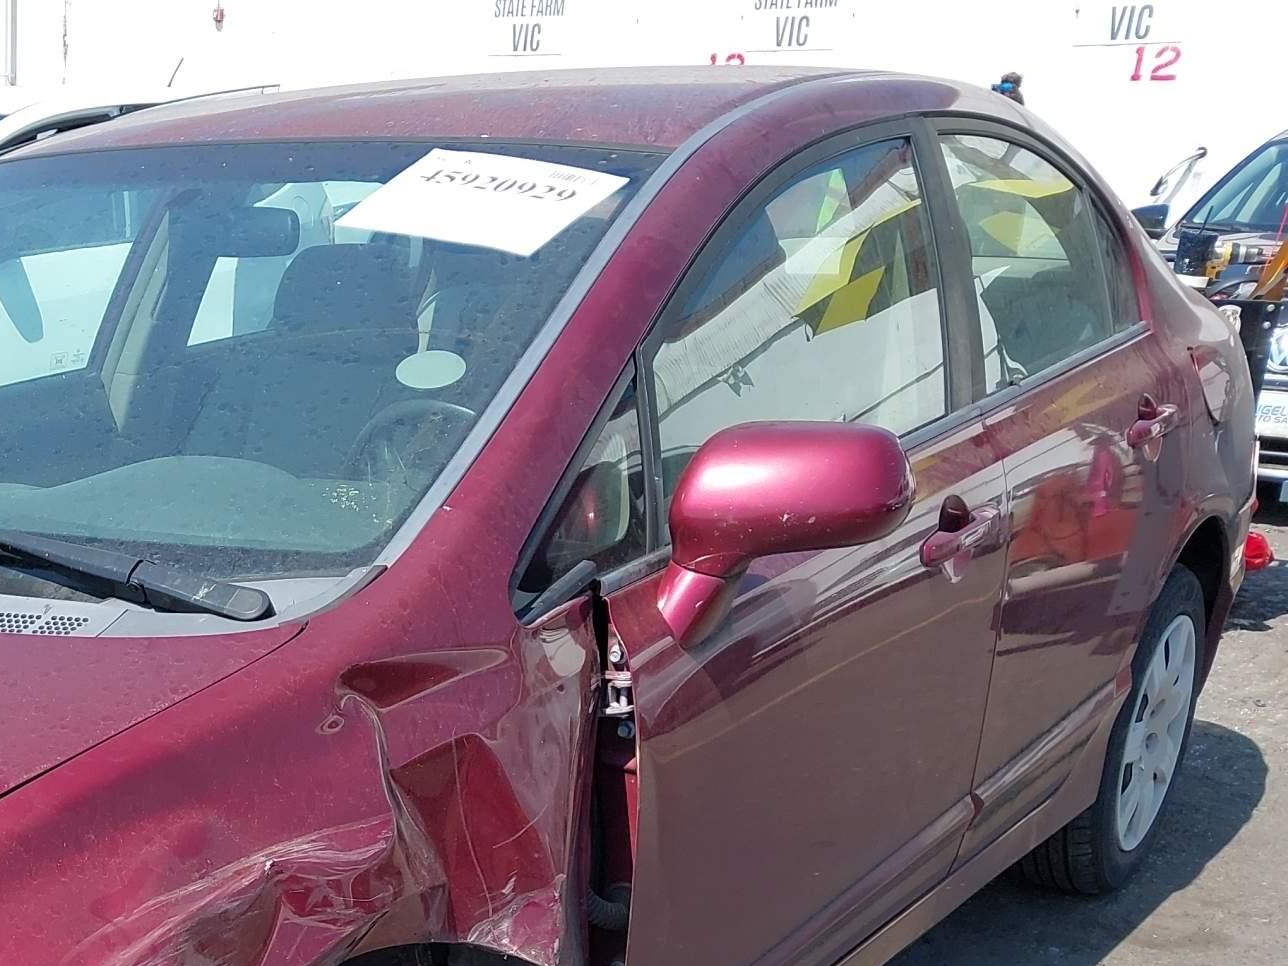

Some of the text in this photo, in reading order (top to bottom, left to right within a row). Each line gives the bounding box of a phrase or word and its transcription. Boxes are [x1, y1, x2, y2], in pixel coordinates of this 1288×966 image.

[494, 0, 565, 18] STATE FARM
[1110, 4, 1154, 40] VIC
[512, 23, 541, 52] VIC
[776, 15, 810, 47] VIC
[1130, 46, 1181, 81] 12
[420, 168, 577, 202] 45920929
